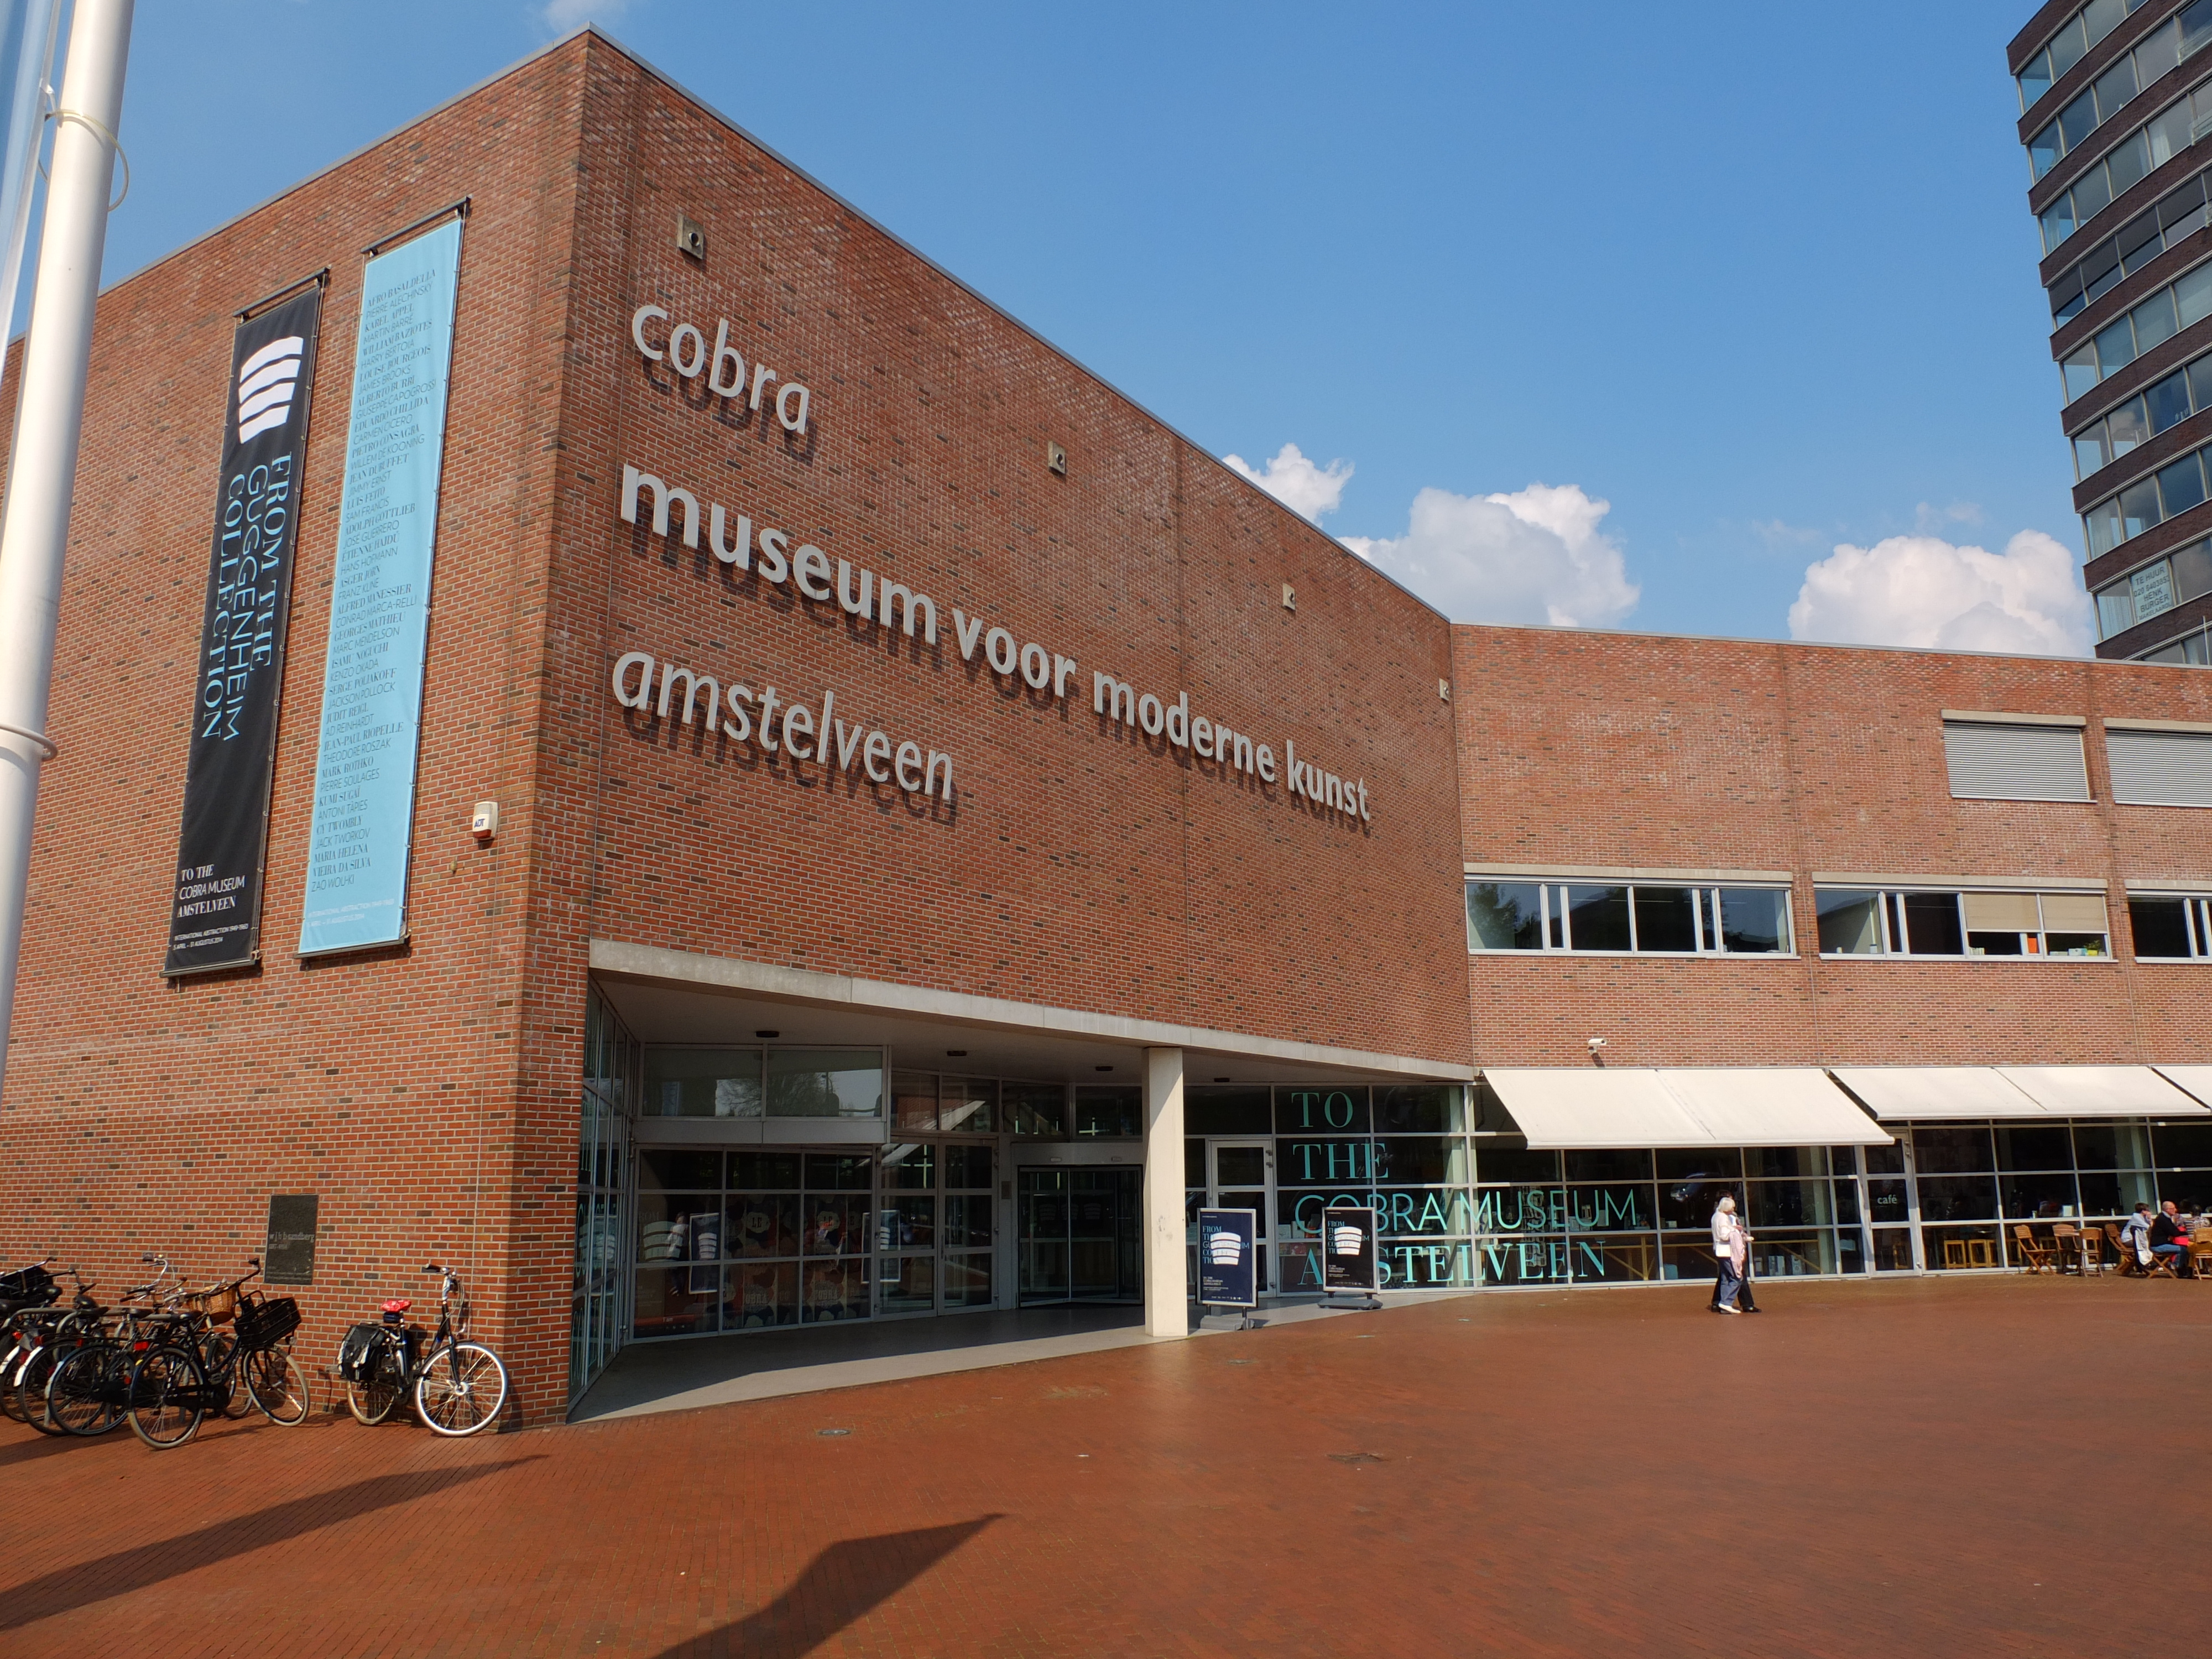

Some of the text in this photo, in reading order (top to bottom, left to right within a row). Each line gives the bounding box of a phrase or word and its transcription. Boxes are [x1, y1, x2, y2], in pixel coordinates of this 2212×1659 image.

[632, 305, 810, 434] cobra
[249, 451, 291, 671] FROM THE
[2135, 566, 2165, 586] TE HUUR
[202, 474, 245, 737] COLLECTION
[223, 465, 268, 740] GUGGENHEIM
[2140, 594, 2169, 612] BURGER
[2143, 587, 2163, 601] HENK
[620, 463, 1370, 821] museum voor moderne kunst
[613, 651, 952, 800] amstelveen
[474, 818, 485, 828] ADT
[179, 875, 246, 900] COBRA MUSEUM
[181, 864, 215, 881] TO THE
[177, 895, 237, 918] AMSTELVEEN
[1291, 1092, 1353, 1128] TO
[1292, 1143, 1389, 1180] THE
[1459, 1188, 1636, 1230] MUSEUM
[1877, 1194, 1898, 1204] café
[1297, 1241, 1606, 1285] ASTELVEEN
